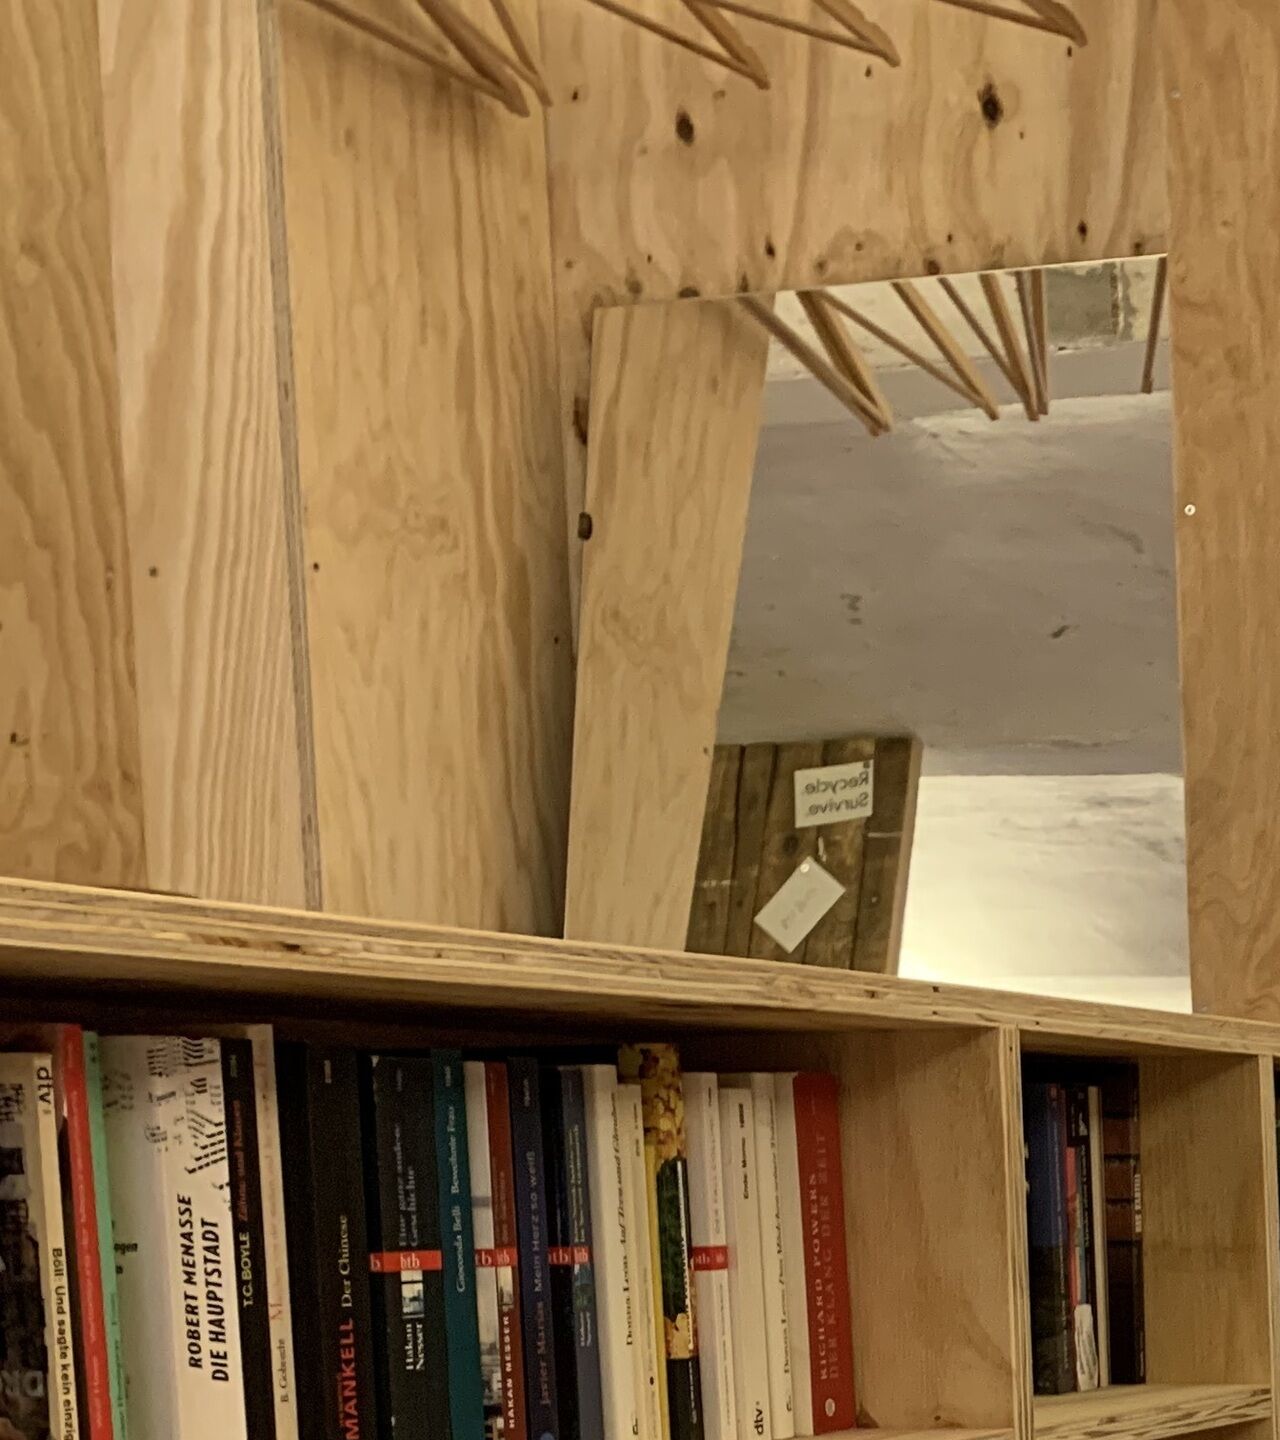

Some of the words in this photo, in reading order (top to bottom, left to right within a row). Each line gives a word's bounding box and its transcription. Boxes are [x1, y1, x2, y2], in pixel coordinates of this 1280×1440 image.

[36, 1066, 52, 1106] dtv
[525, 1150, 537, 1186] weiß
[815, 1130, 828, 1185] ZEIT
[530, 1214, 541, 1251] Herz
[809, 1173, 821, 1268] POWERS
[820, 1194, 832, 1238] DER
[176, 1193, 197, 1286] MENASSE
[239, 1231, 252, 1281] BOYLE
[337, 1214, 351, 1276] Chinese
[201, 1218, 227, 1346] HAUPTSTADT
[340, 1279, 353, 1308] Der
[533, 1255, 543, 1292] Mein
[621, 1254, 630, 1292] Leon
[823, 1246, 836, 1326] KLANG
[54, 1285, 66, 1315] Und
[625, 1298, 633, 1346] Donna
[56, 1318, 72, 1361] sagte
[183, 1291, 204, 1369] ROBERT
[415, 1322, 425, 1371] Nesser
[502, 1316, 512, 1372] NESSER
[815, 1278, 828, 1382] RICHARD
[60, 1363, 73, 1396] kein
[209, 1350, 230, 1381] DIE
[340, 1317, 360, 1440] MANKELL
[827, 1337, 840, 1380] DER
[751, 1407, 764, 1437] dtv
